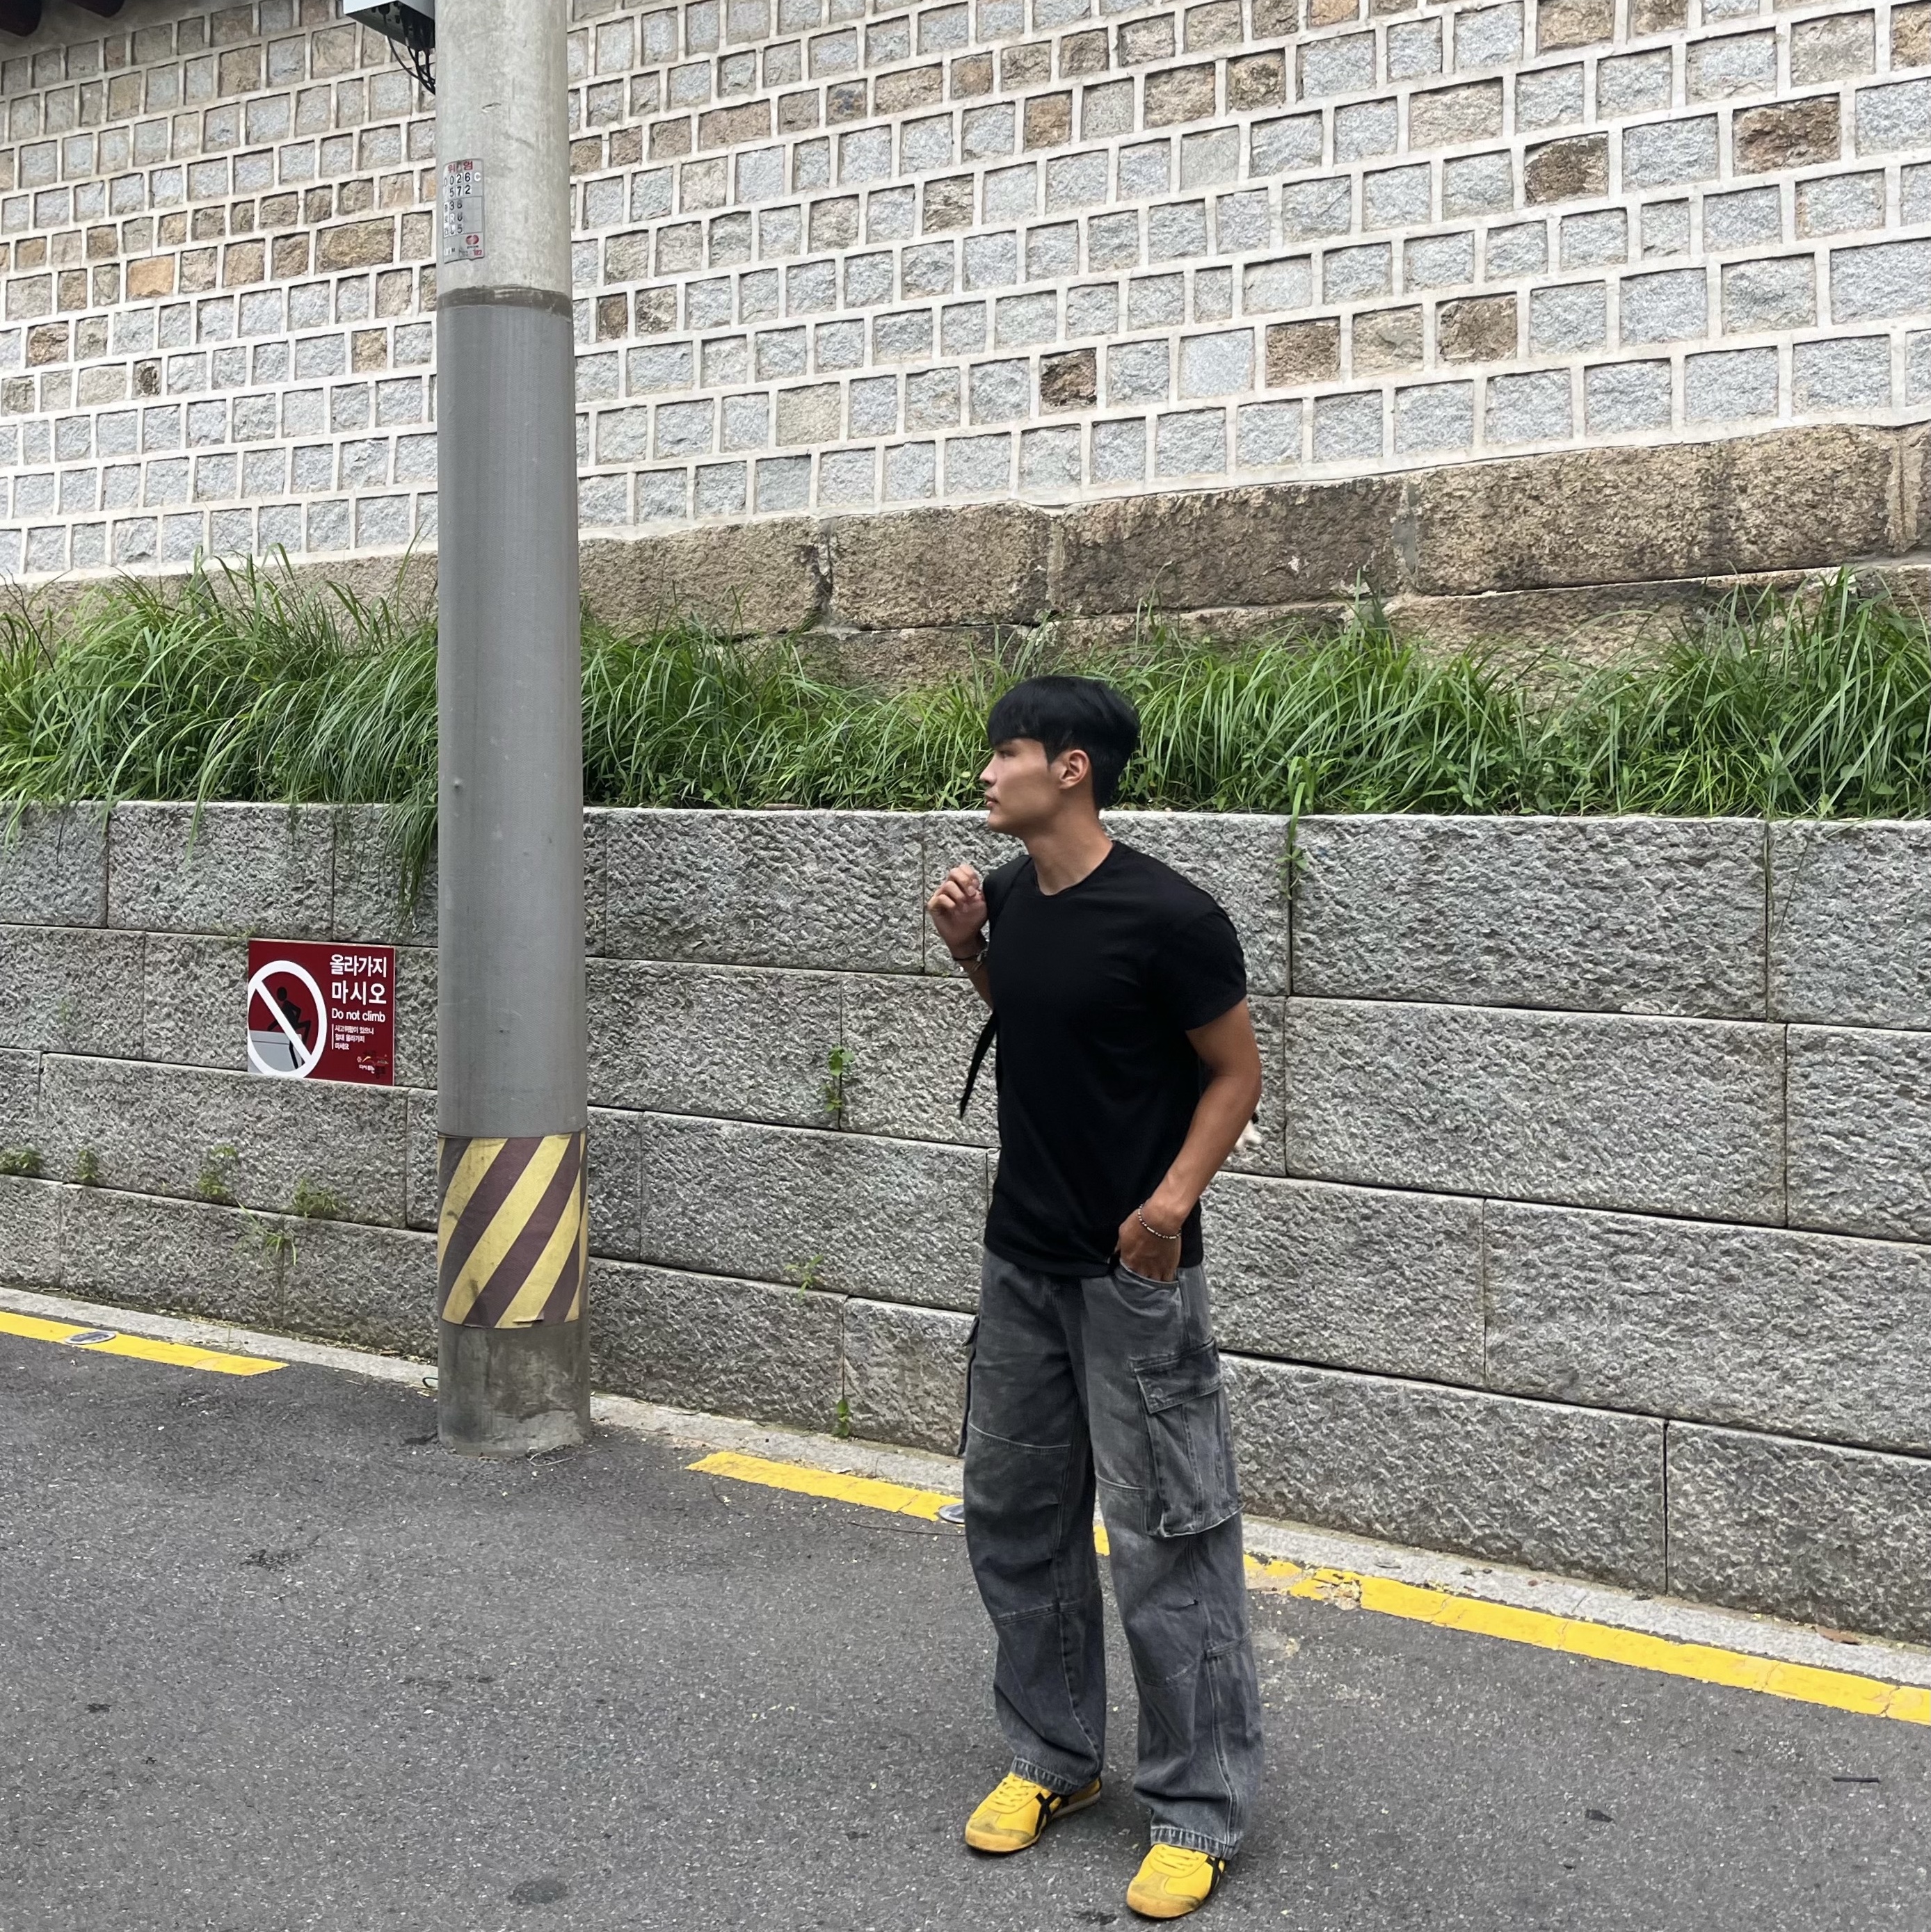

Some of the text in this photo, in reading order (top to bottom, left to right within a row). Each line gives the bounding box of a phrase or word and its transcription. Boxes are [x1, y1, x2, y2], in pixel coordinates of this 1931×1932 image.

[330, 953, 387, 978] 올라가지
[332, 980, 387, 1006] 마시오
[332, 1008, 386, 1022] Do not climb
